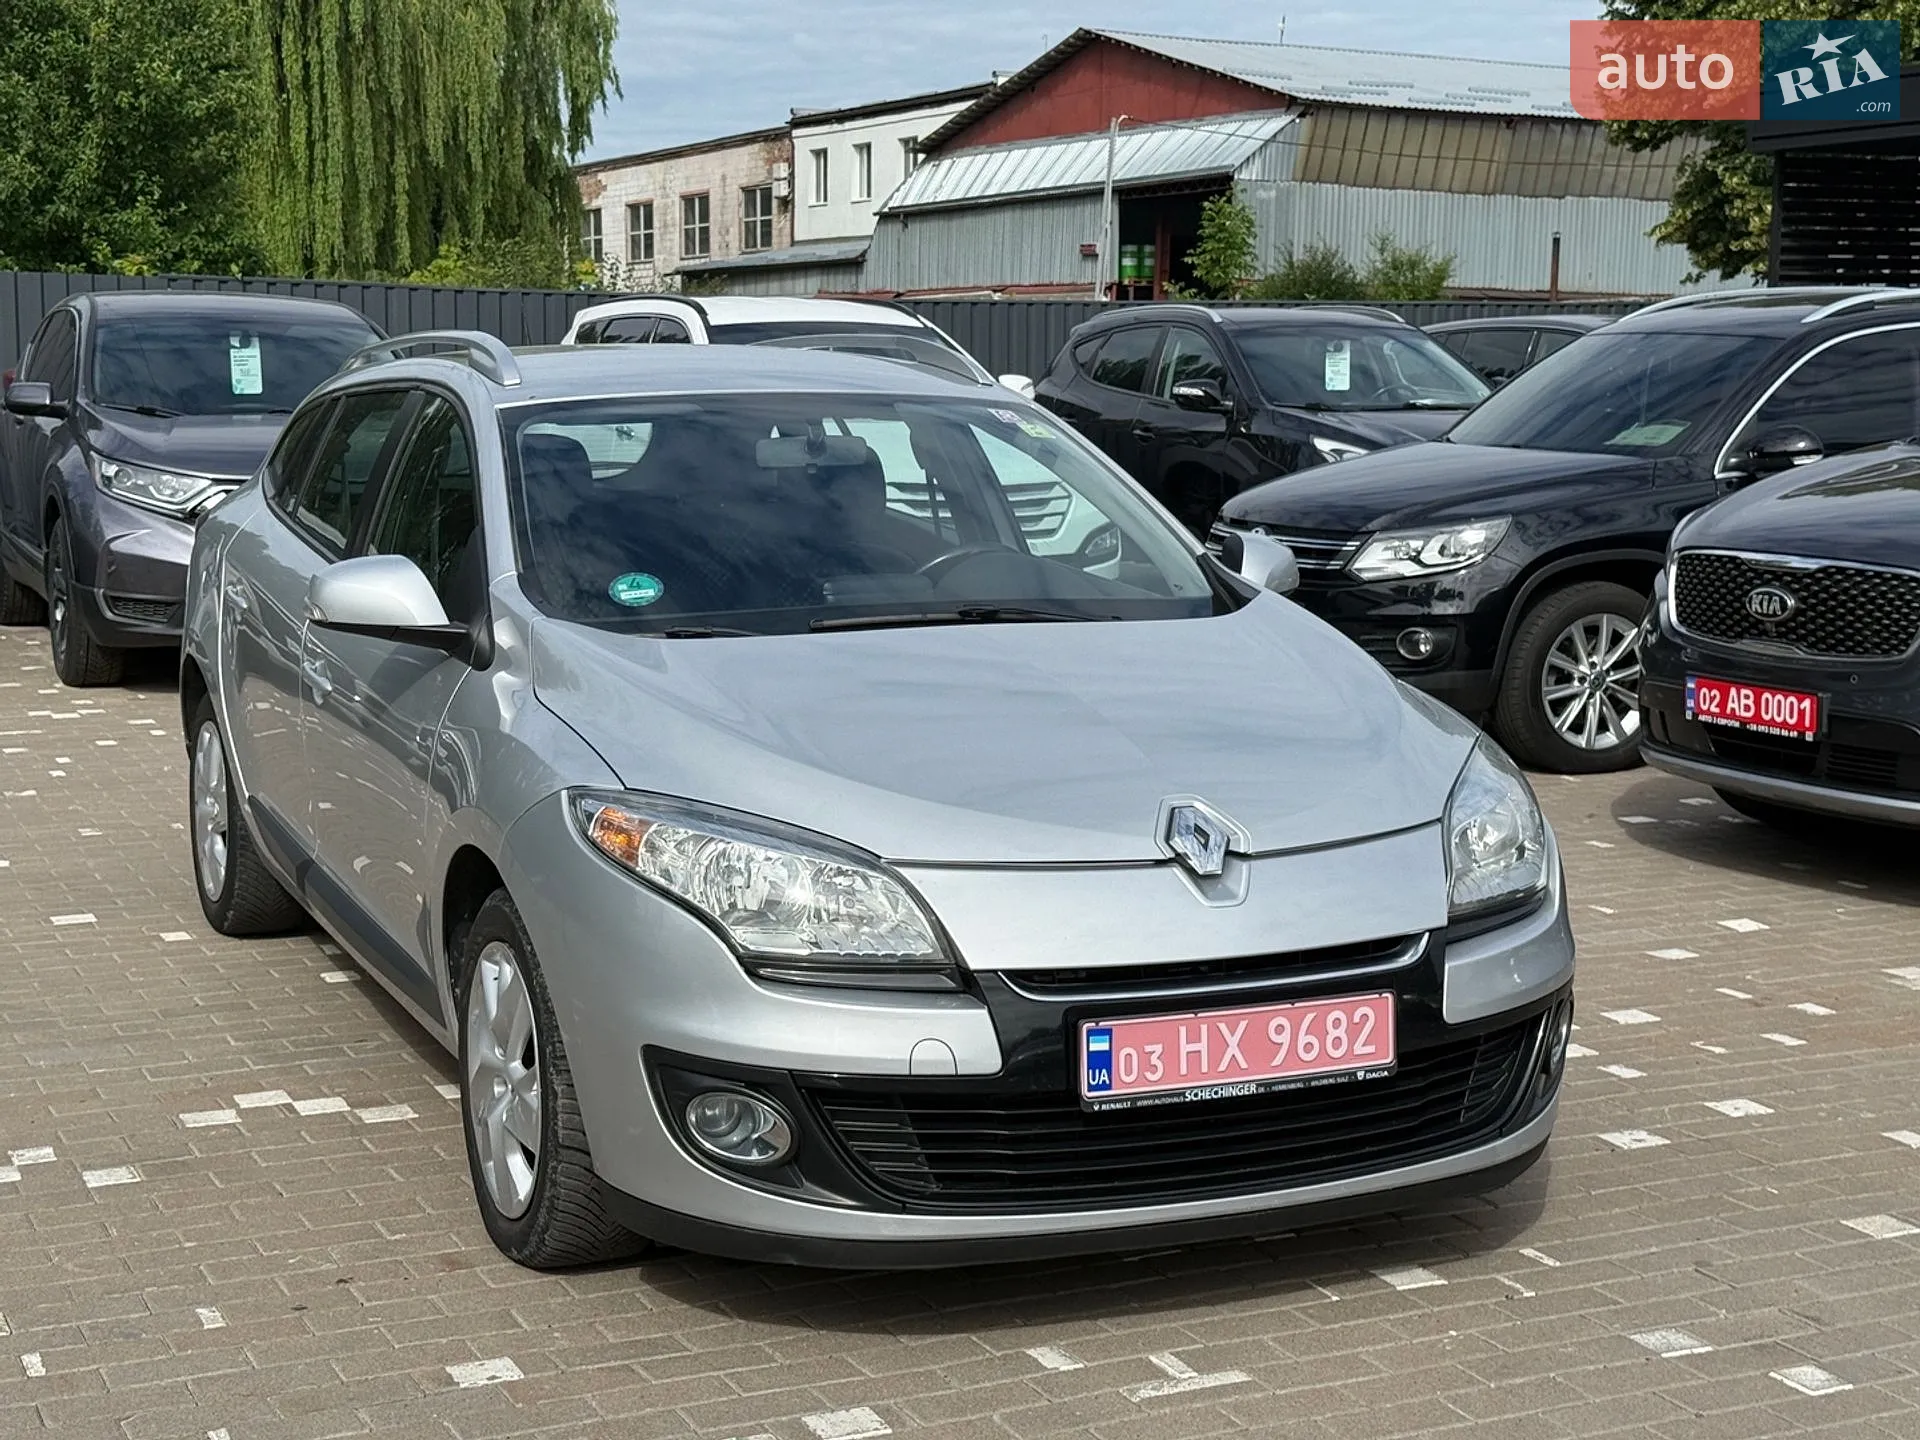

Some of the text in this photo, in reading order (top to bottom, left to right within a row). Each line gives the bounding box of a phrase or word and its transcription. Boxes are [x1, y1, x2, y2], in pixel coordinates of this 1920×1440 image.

[1750, 593, 1782, 615] KIA
[1699, 687, 1811, 728] 02 AB 0001
[1118, 1006, 1376, 1083] 03 HX 9682
[1089, 1069, 1110, 1086] UA
[1101, 1101, 1131, 1111] RENAULT
[1185, 1083, 1257, 1101] SCHECHINGER
[1365, 1070, 1390, 1079] DACIA
